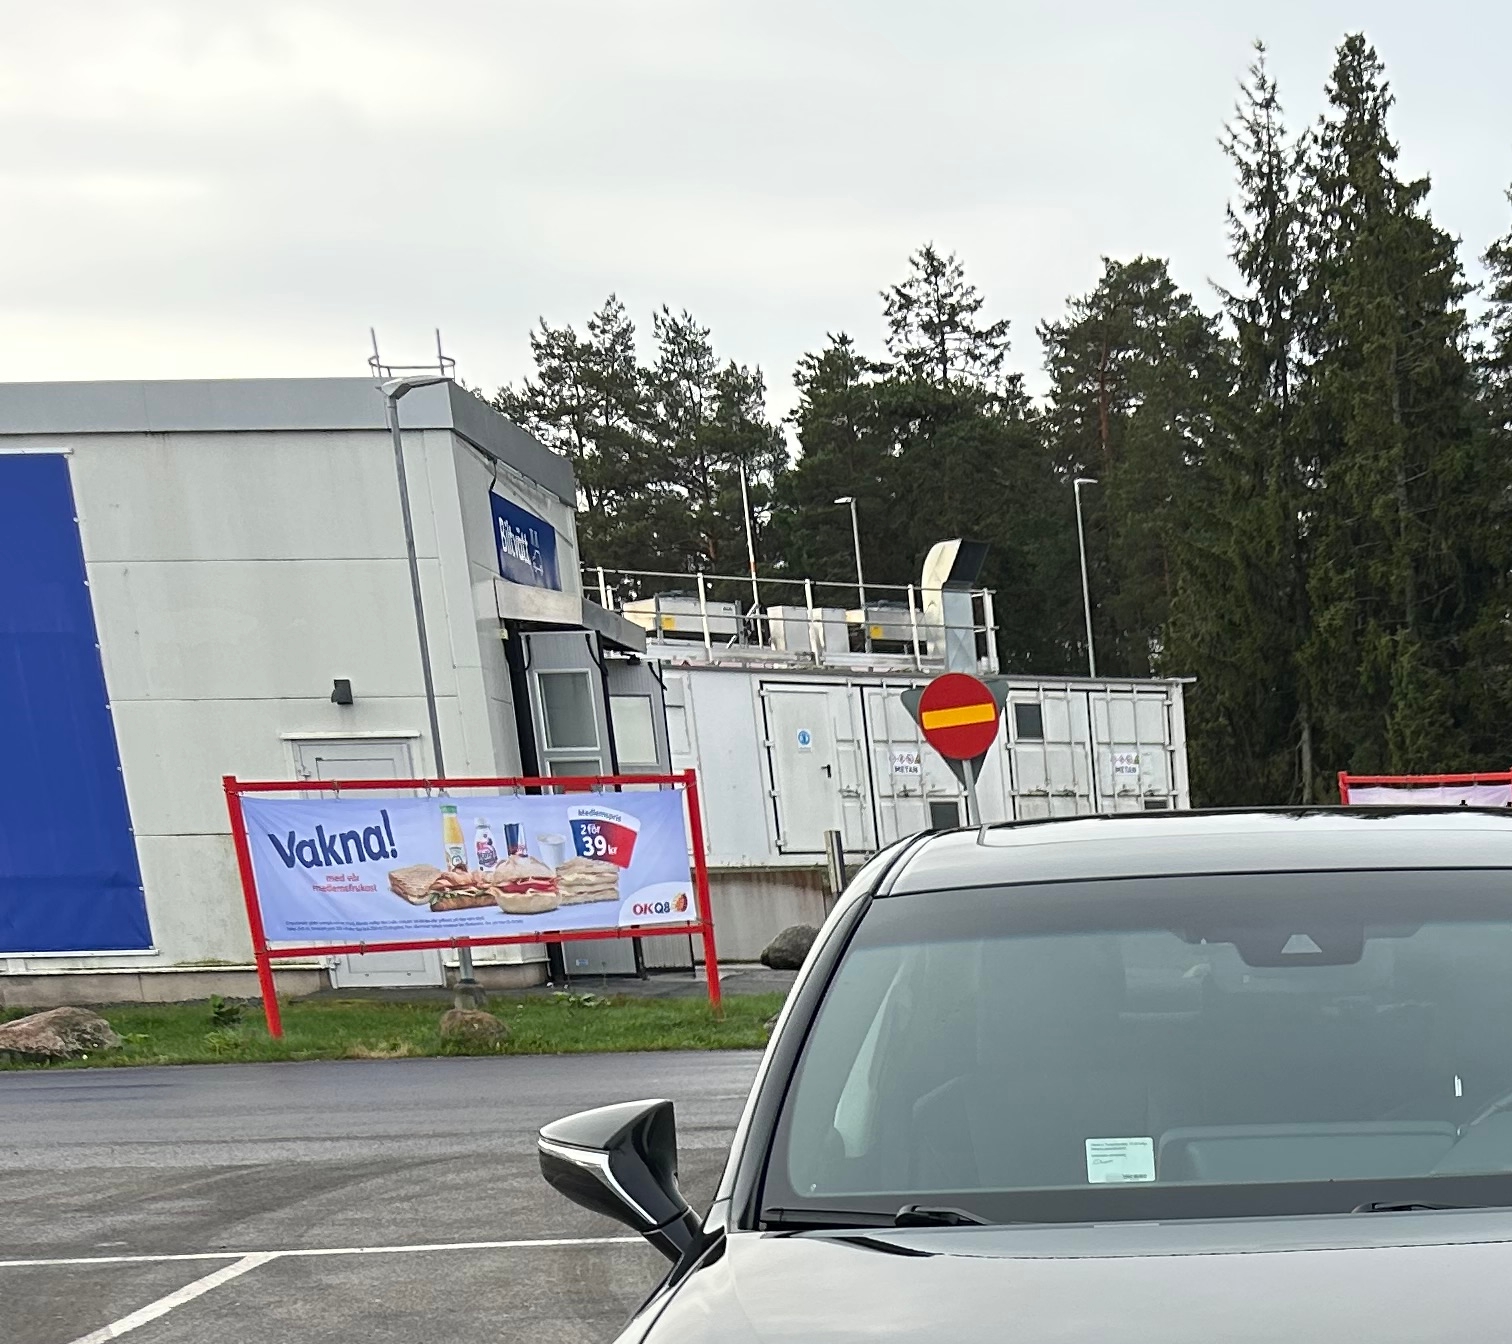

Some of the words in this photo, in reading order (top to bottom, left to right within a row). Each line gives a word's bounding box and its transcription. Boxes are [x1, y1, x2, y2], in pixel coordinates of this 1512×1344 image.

[268, 809, 398, 869] Vakna!
[580, 823, 587, 836] 2
[587, 823, 601, 836] för
[582, 835, 607, 857] 39
[607, 844, 618, 856] kr
